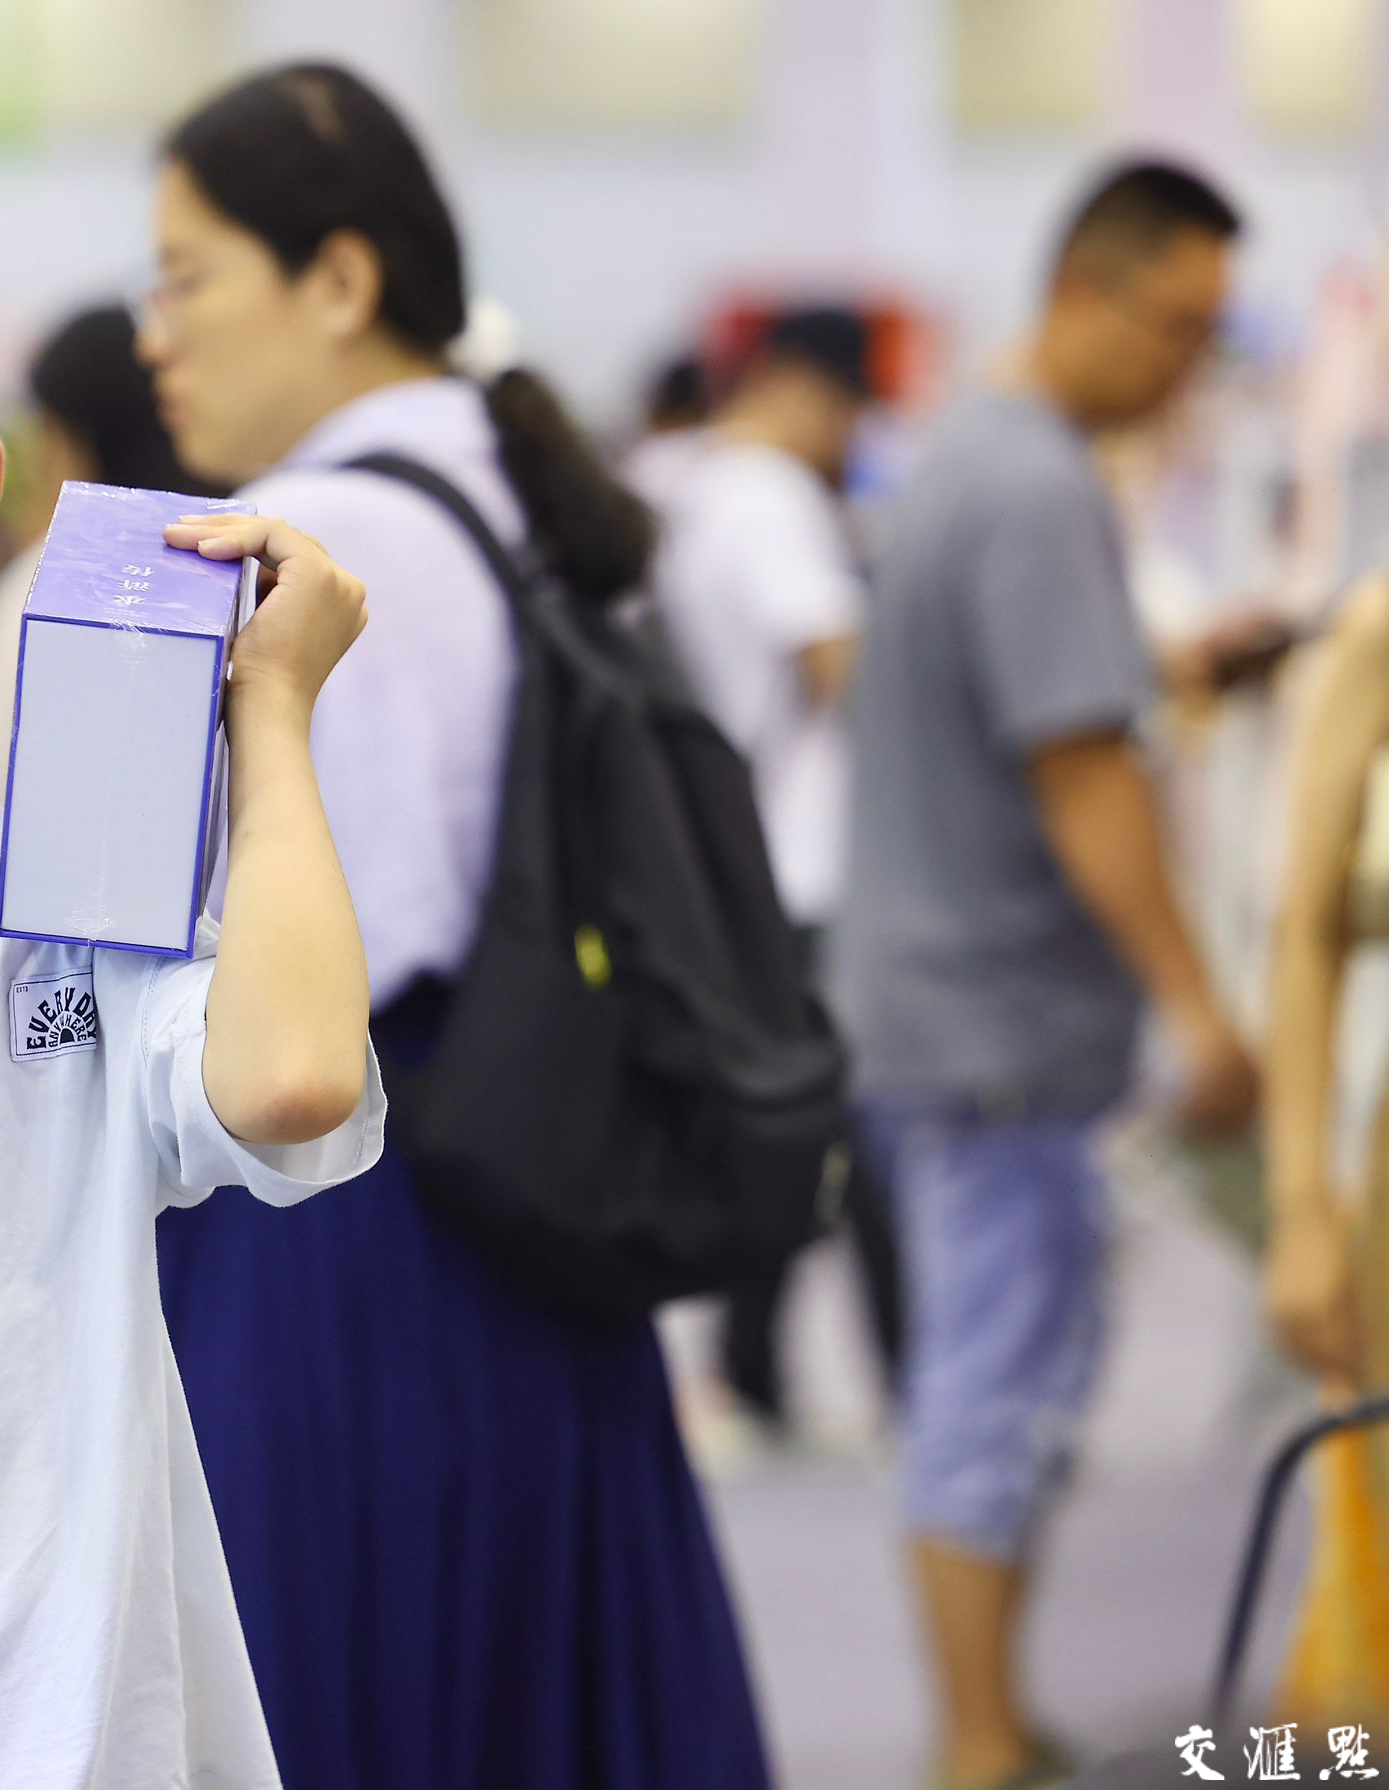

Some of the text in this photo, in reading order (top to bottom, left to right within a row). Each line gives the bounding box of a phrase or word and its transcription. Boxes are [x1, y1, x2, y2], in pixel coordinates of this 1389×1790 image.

[113, 565, 154, 605] 水浒传
[48, 1014, 87, 1048] ANYWHERE
